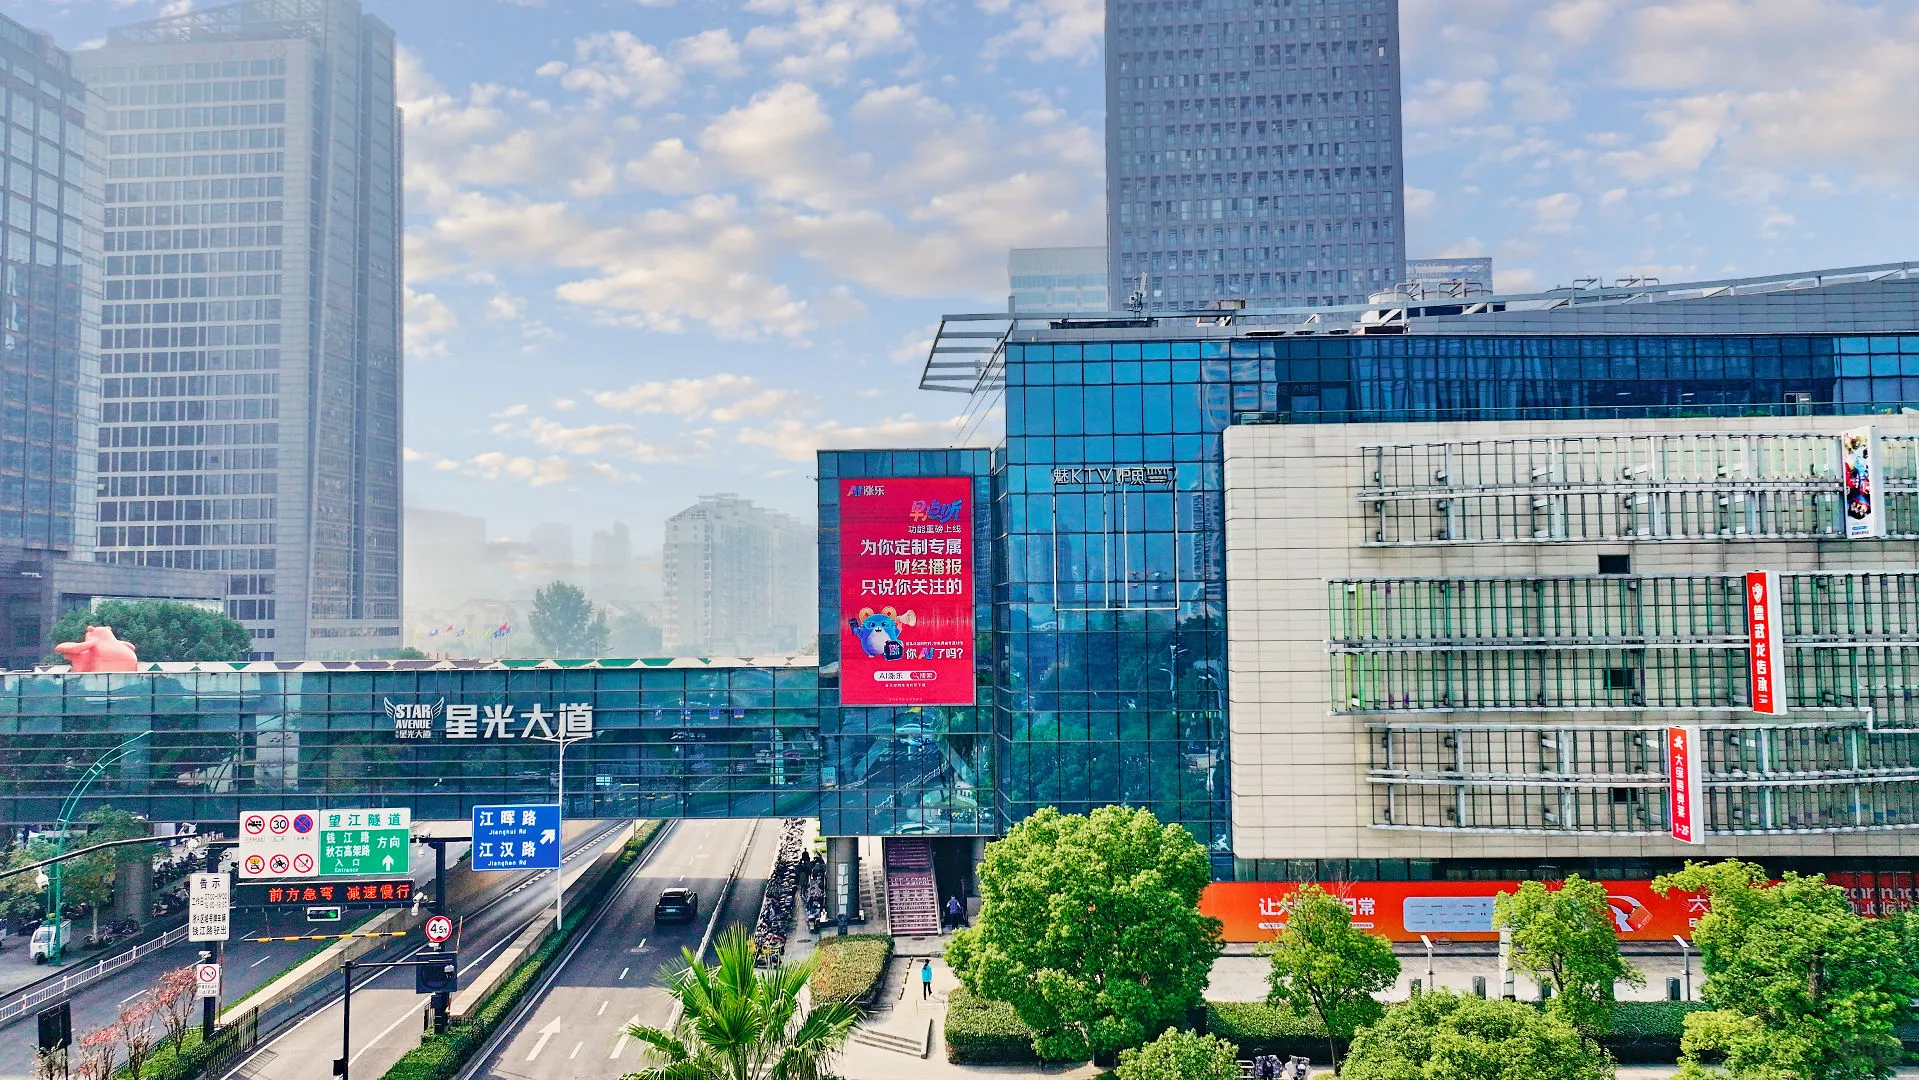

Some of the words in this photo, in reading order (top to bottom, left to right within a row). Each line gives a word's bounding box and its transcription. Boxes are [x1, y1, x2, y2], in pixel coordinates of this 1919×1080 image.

[909, 499, 962, 523] 早点听
[908, 525, 961, 533] 功能重磅上线
[861, 539, 962, 555] 为你定制专属
[894, 559, 962, 575] 财经播报
[861, 578, 962, 595] 只说你关注的
[395, 704, 431, 718] STAR
[395, 719, 432, 729] AVENUE
[446, 703, 593, 738] 星光大道
[273, 820, 287, 830] 30
[328, 813, 401, 828] 望江隧道
[479, 809, 536, 827] 江晖路
[326, 831, 370, 844] 钱江路
[376, 836, 400, 849] 方向
[325, 845, 370, 858] 秋石高架路
[479, 841, 536, 858] 江汉路
[334, 858, 360, 867] 入口
[200, 878, 220, 889] 告示
[269, 886, 335, 903] 前方急弯
[346, 884, 411, 901] 减速慢行
